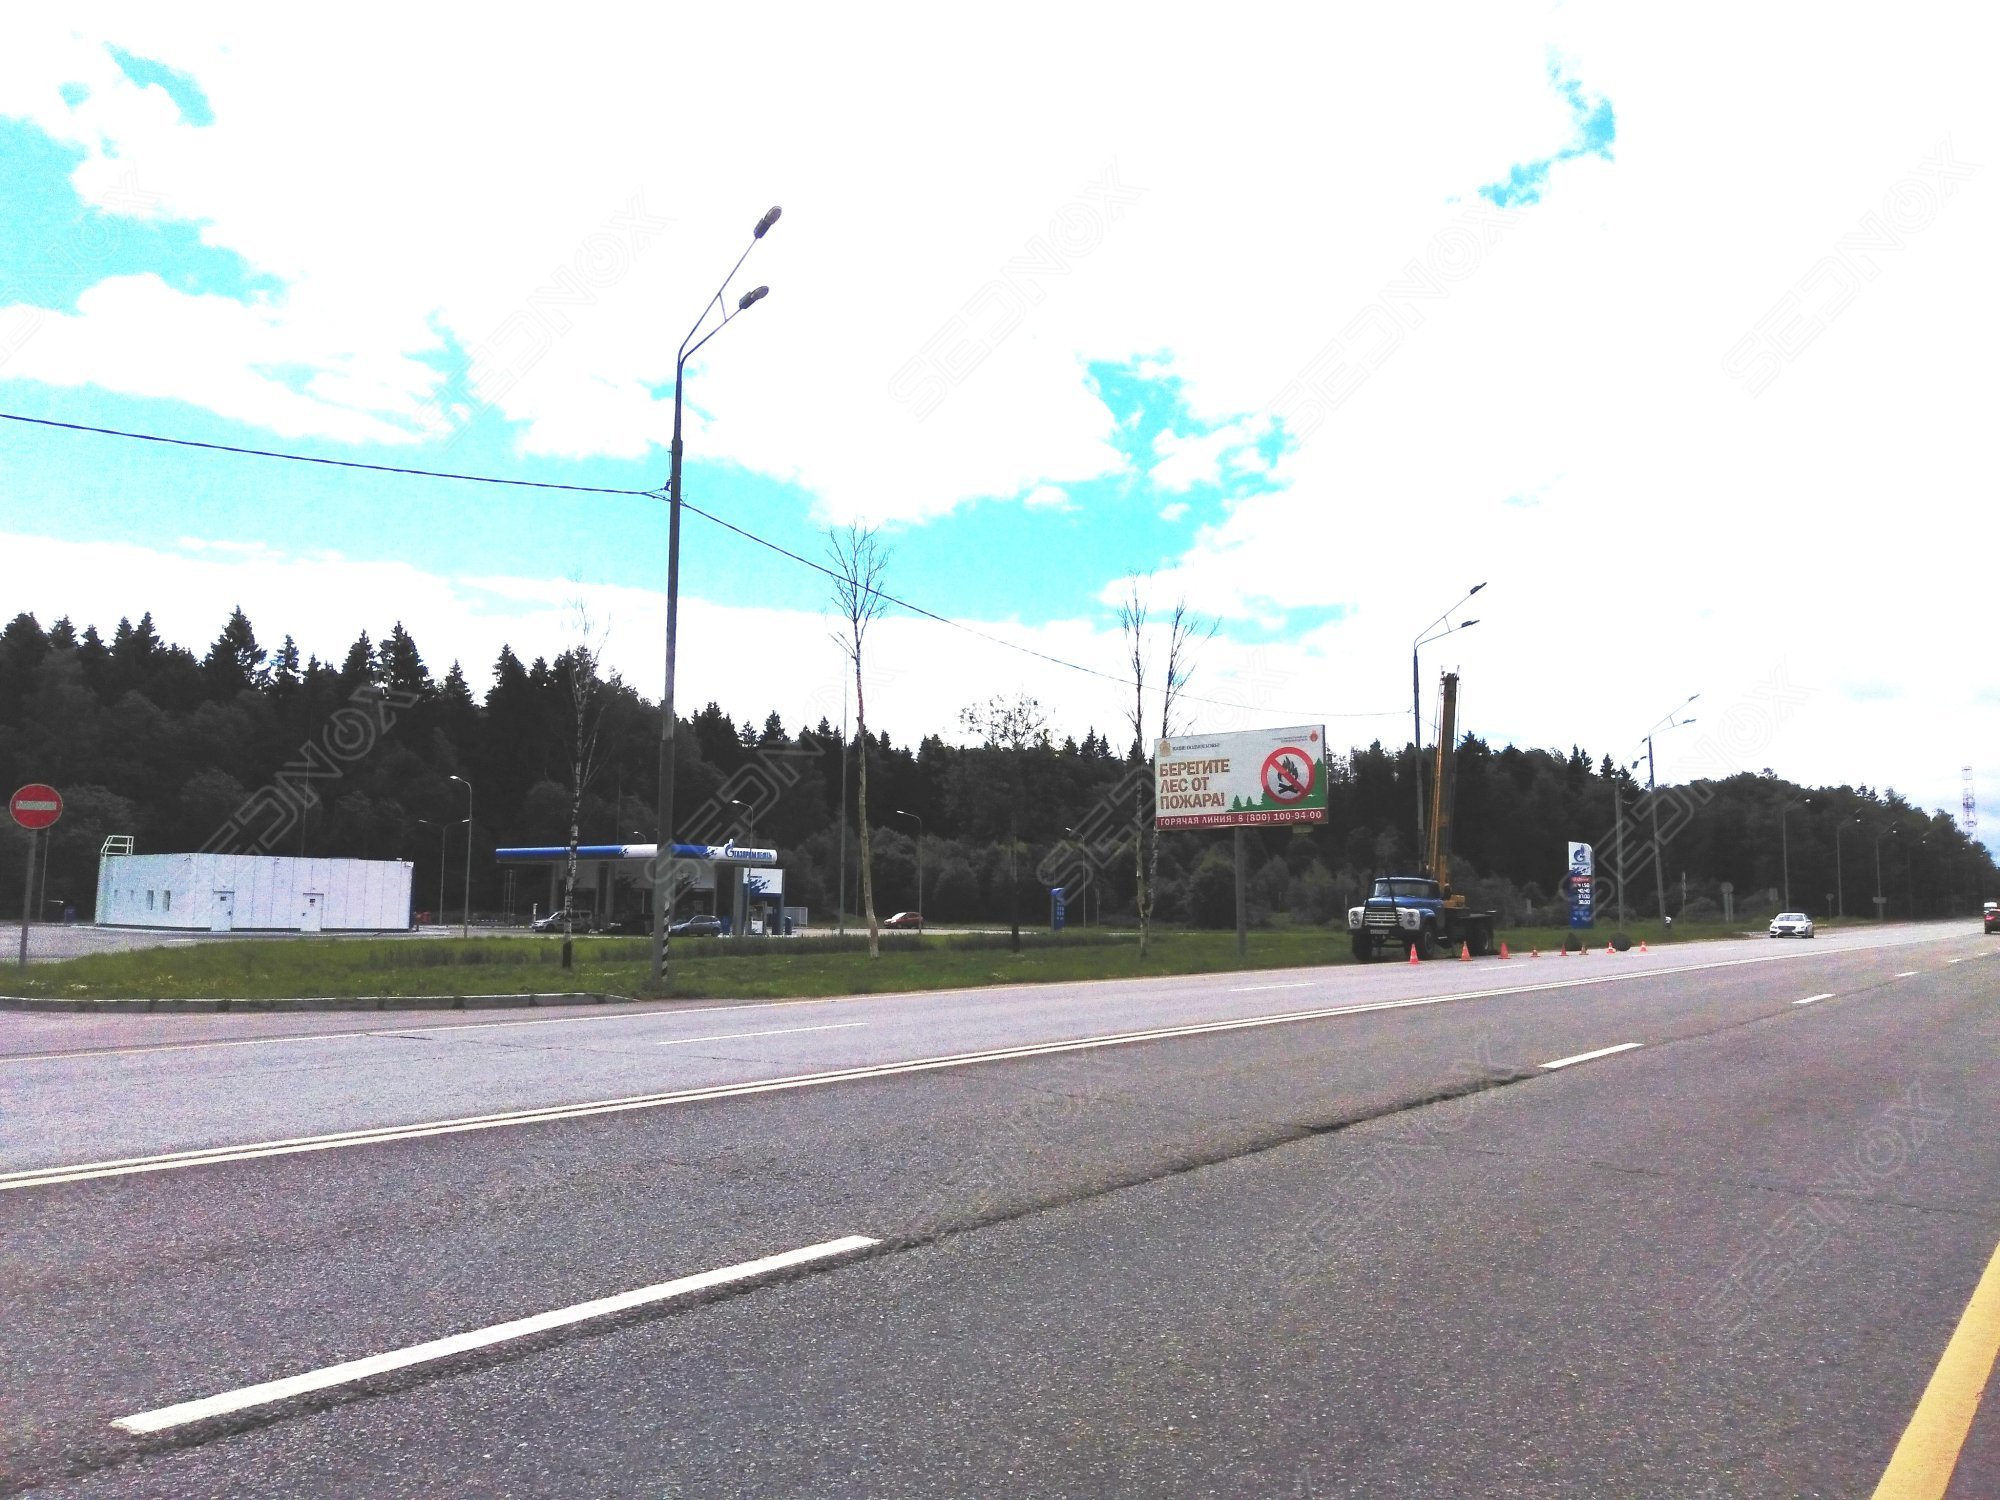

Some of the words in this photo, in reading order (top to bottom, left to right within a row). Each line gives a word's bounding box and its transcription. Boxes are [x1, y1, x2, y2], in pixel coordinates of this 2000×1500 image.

[1159, 759, 1230, 777] БЕРЕГИТЕ
[1160, 778, 1188, 793] ЛЕС
[1191, 777, 1209, 791] ОТ
[1160, 792, 1225, 809] ПОЖАРА!
[1160, 816, 1199, 826] ГОРЯЧАЯ
[1202, 815, 1235, 824] ЛИНИЯ:
[1238, 814, 1243, 822] 8
[1246, 813, 1270, 823] (800)
